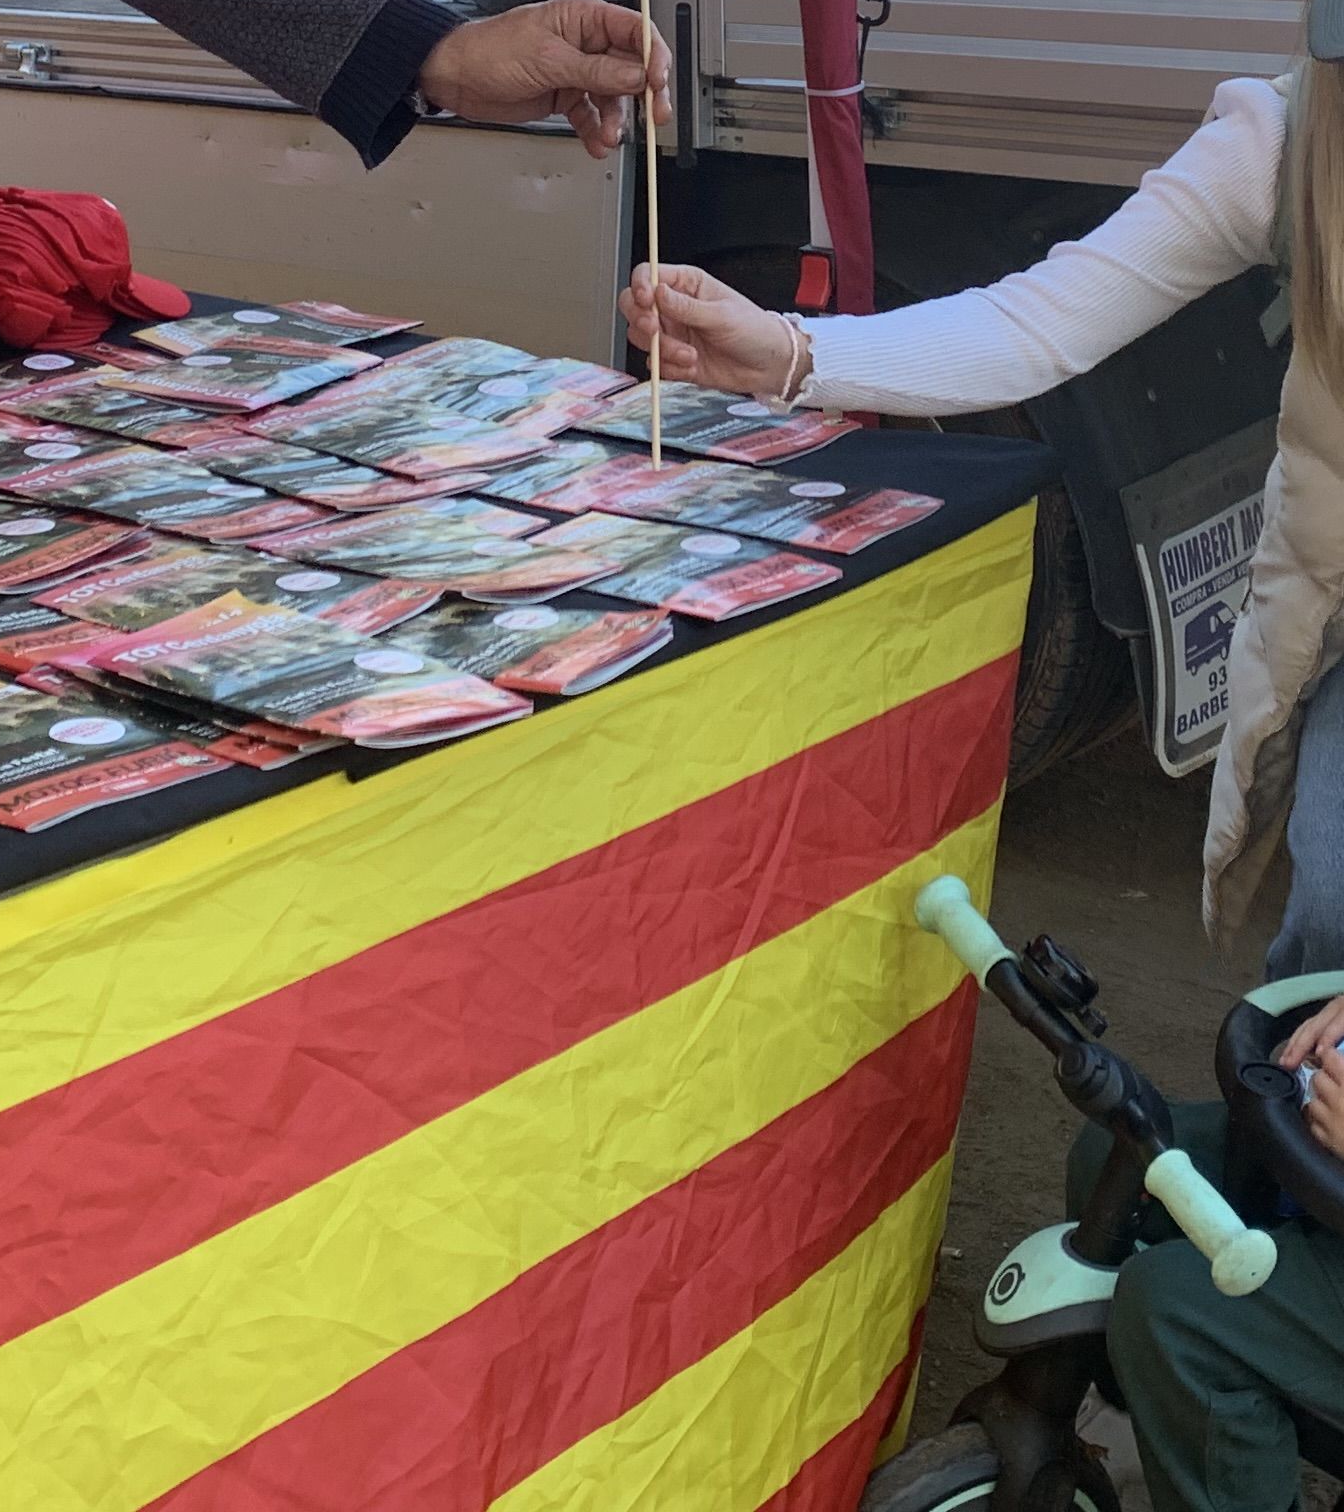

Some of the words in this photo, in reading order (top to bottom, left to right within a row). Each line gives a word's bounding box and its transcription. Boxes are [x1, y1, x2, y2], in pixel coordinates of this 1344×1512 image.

[1161, 515, 1238, 595] HUMBERT
[112, 639, 172, 664] TOT
[1208, 665, 1229, 692] 93
[1176, 690, 1229, 737] BARBE
